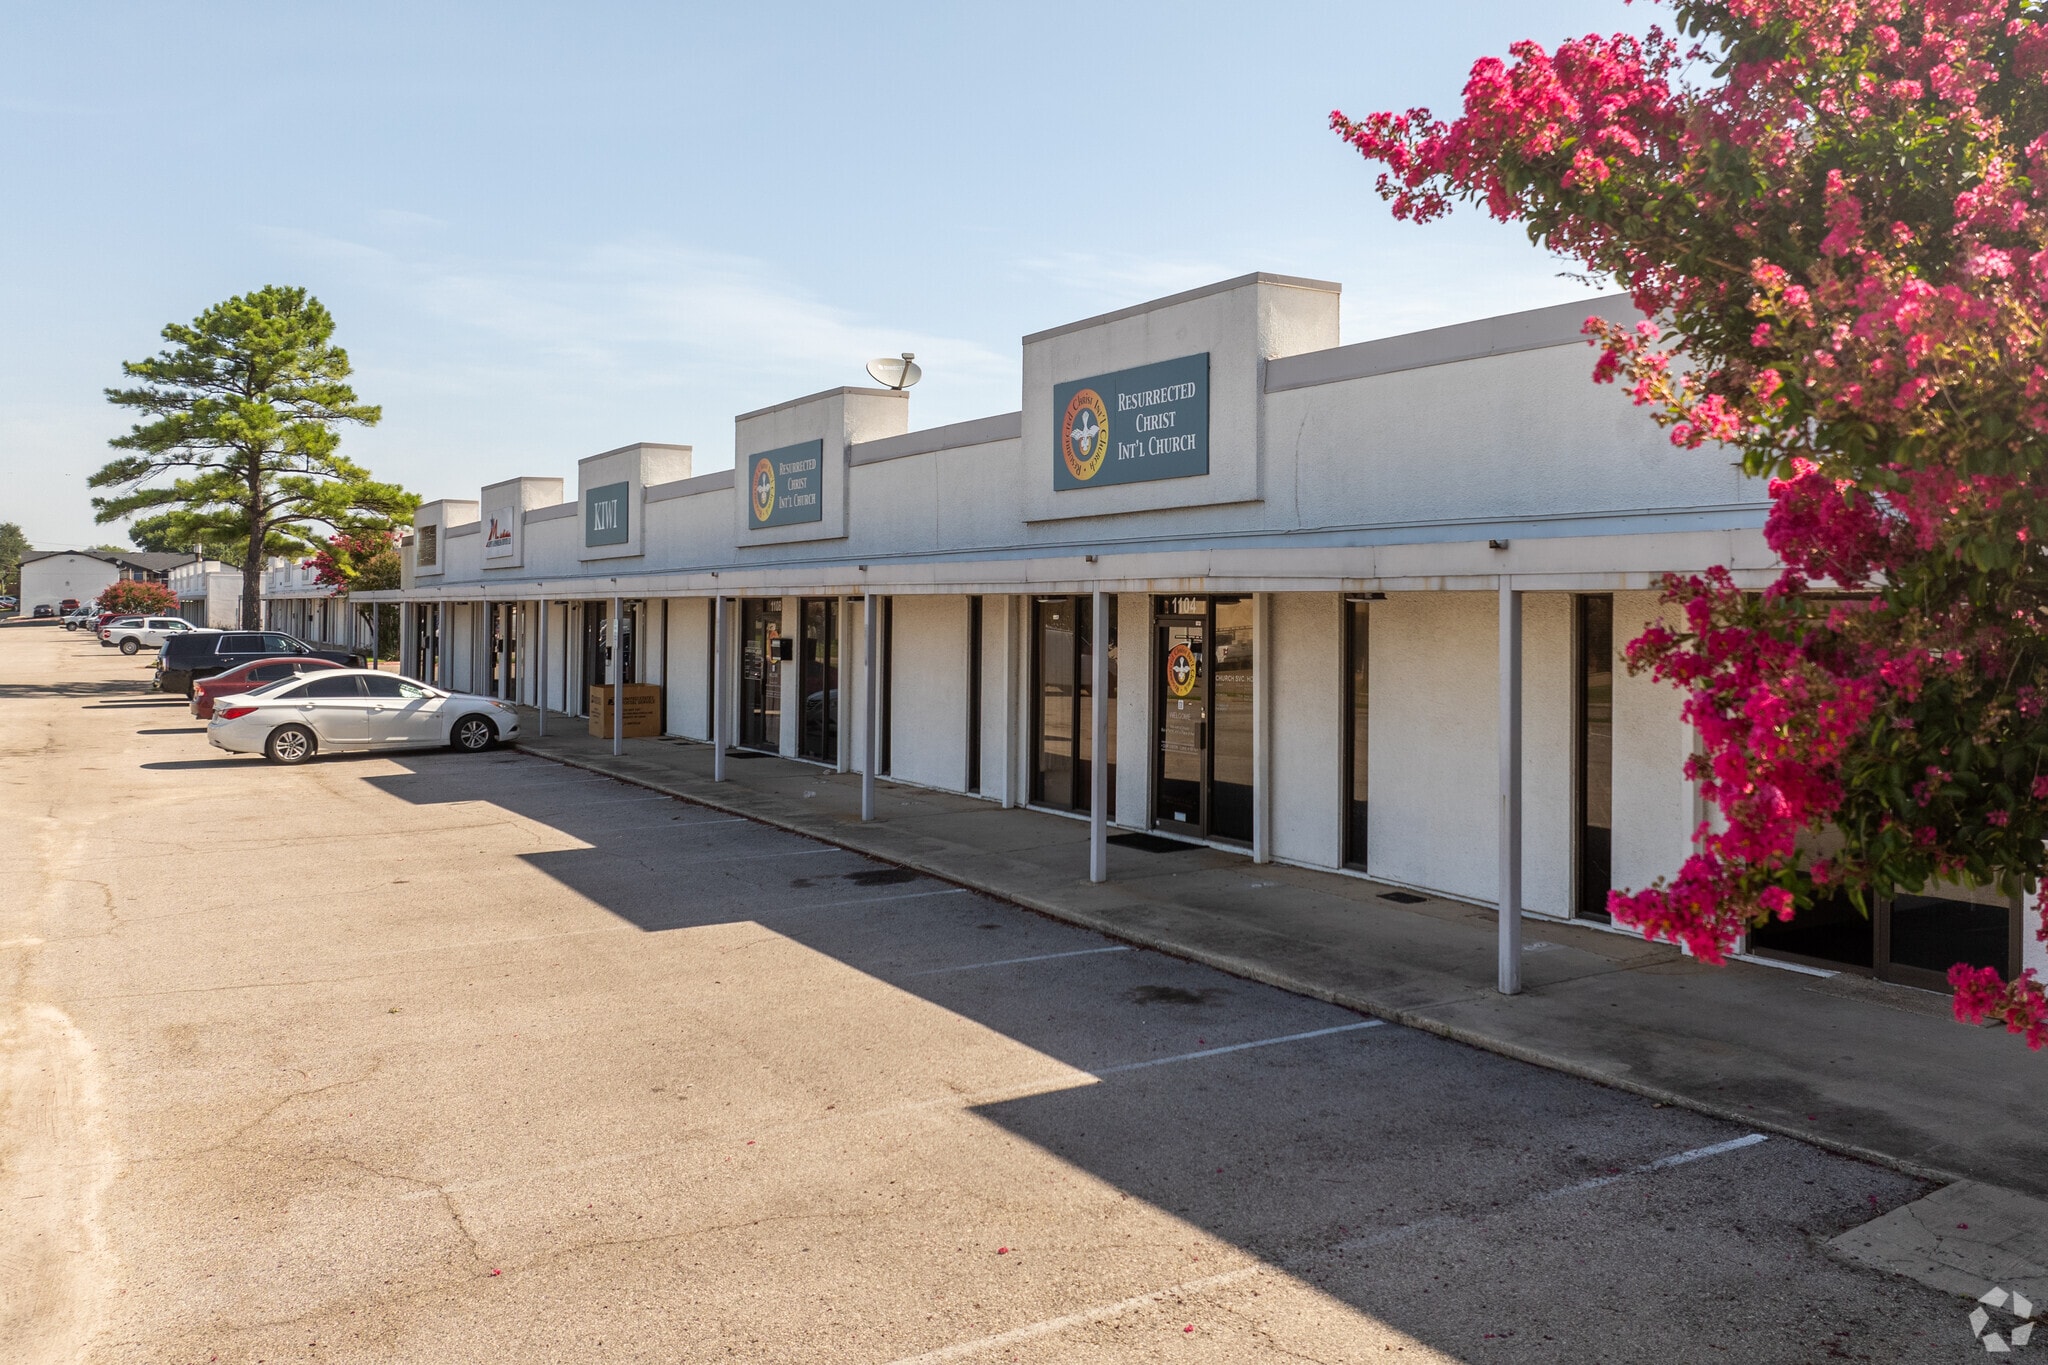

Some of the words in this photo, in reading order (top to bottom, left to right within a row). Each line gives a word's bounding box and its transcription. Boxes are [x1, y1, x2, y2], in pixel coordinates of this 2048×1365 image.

[1118, 381, 1196, 412] RESURRECTED
[1136, 411, 1176, 433] CHRIST
[1118, 439, 1146, 461] INT'L
[1149, 434, 1196, 456] CHURCH
[779, 459, 817, 476] RESURRECTED
[787, 477, 808, 491] CHRIST
[794, 494, 816, 507] CHURCH
[594, 499, 618, 530] KIWI
[1172, 597, 1197, 614] 1104
